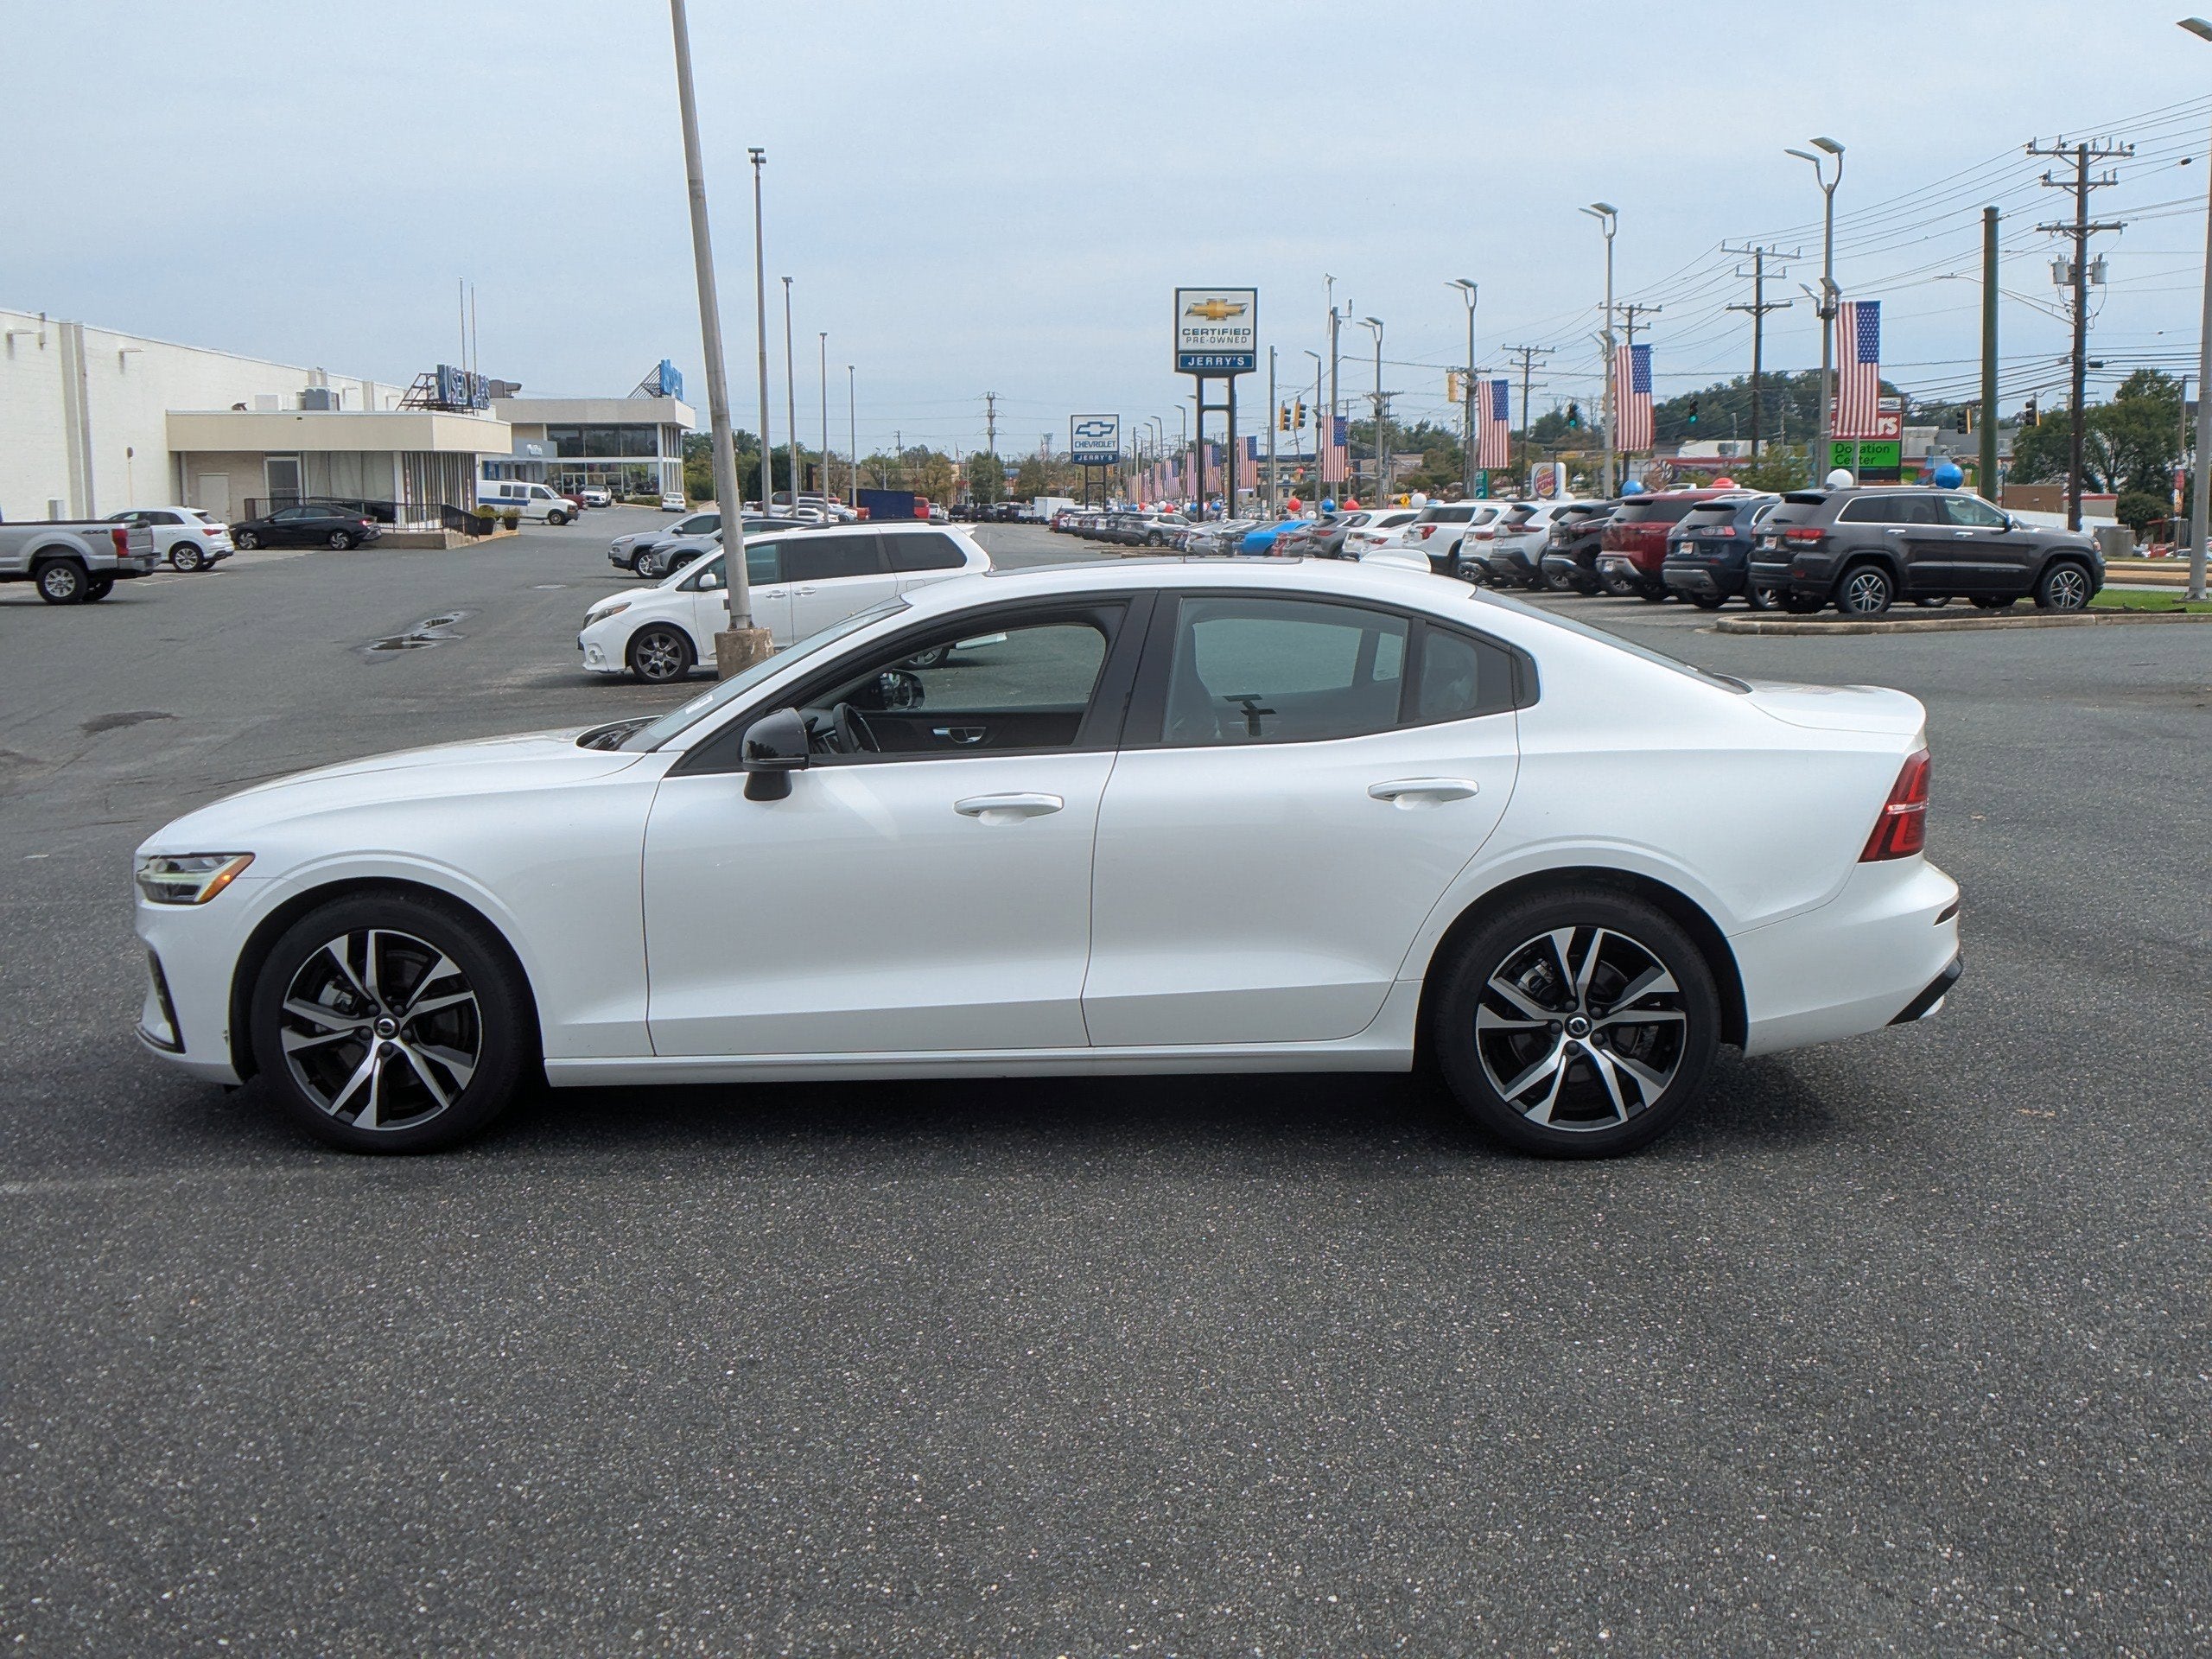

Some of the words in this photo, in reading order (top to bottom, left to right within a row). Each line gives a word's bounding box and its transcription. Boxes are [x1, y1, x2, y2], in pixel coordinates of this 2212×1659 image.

[1182, 327, 1251, 336] CERTIFIED
[1188, 356, 1244, 366] JERRY'S
[441, 364, 467, 405] USED
[1835, 442, 1891, 454] Doation
[1834, 454, 1876, 465] Ceter
